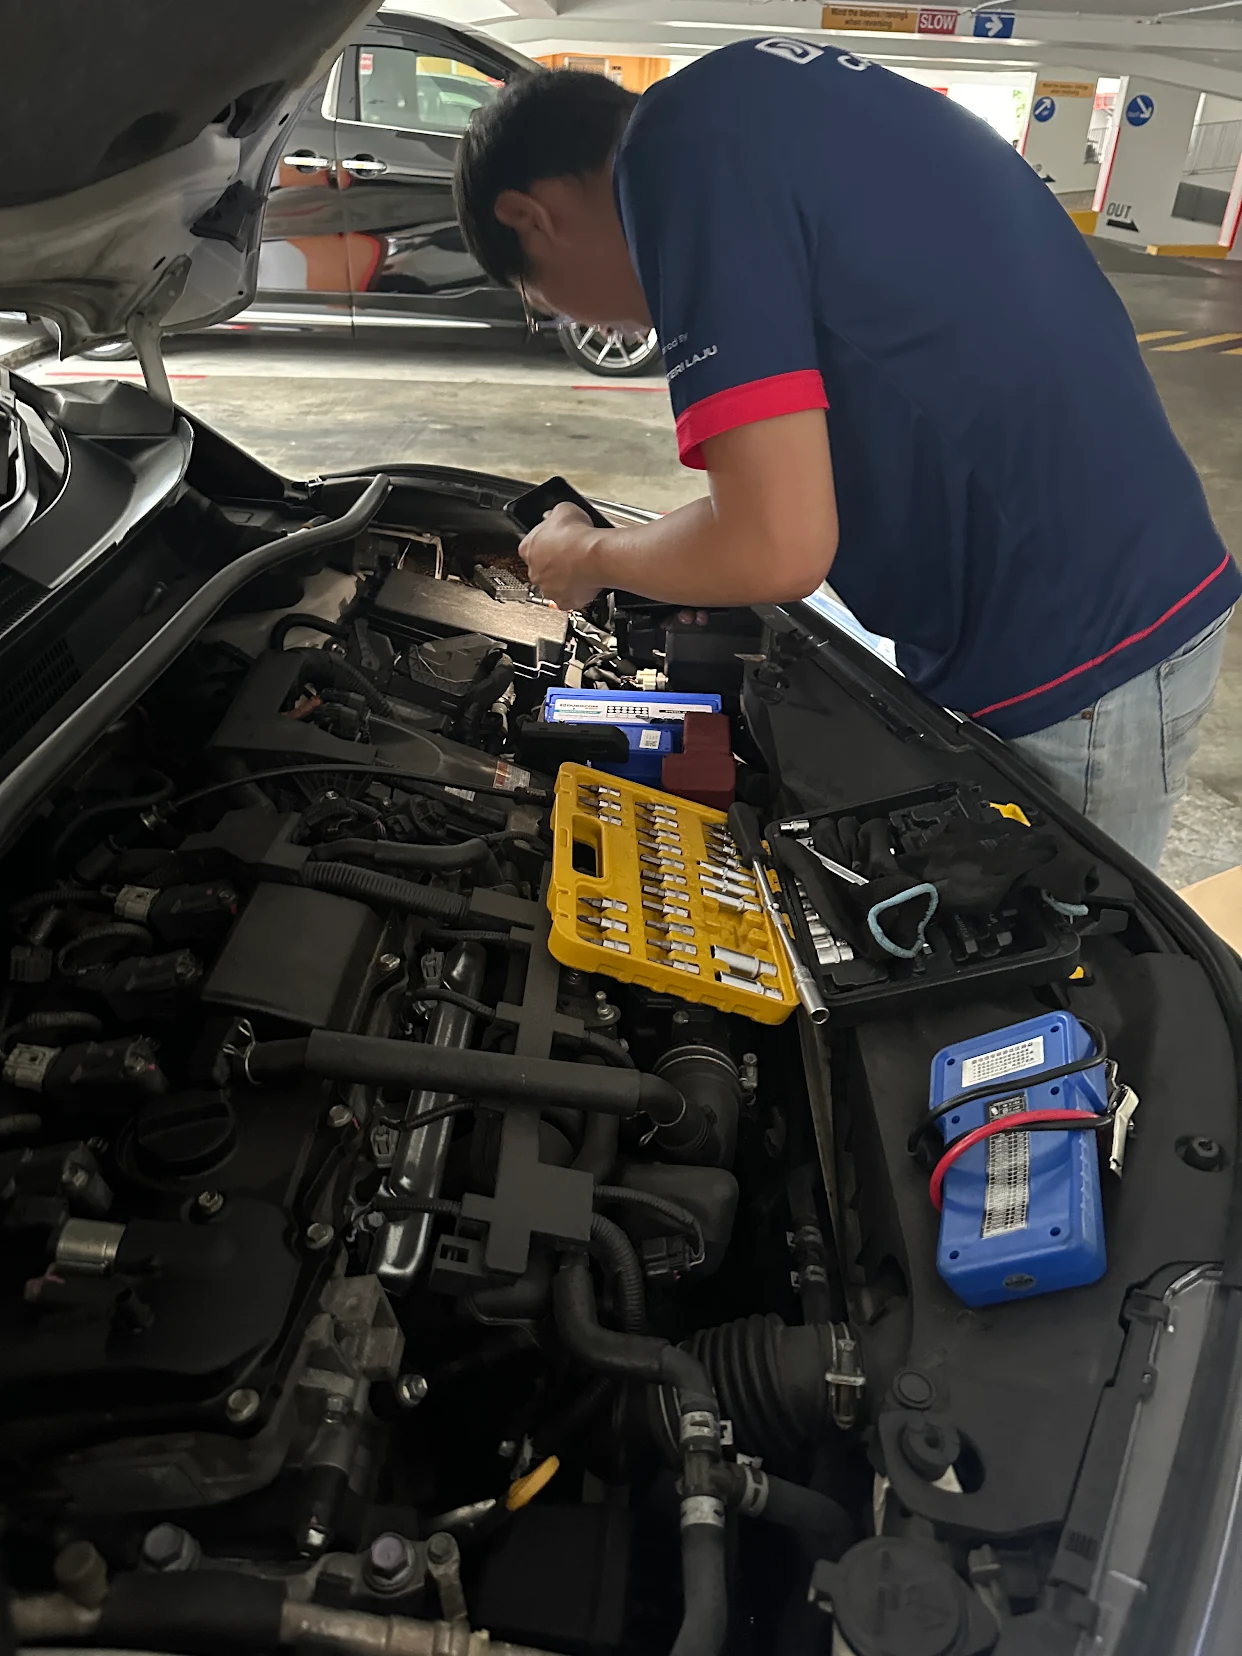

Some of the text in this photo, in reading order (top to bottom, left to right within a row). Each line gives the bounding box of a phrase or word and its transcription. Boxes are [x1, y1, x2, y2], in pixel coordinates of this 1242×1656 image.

[920, 13, 956, 30] SLOW
[1106, 202, 1132, 219] OUT
[685, 344, 718, 368] LAJU
